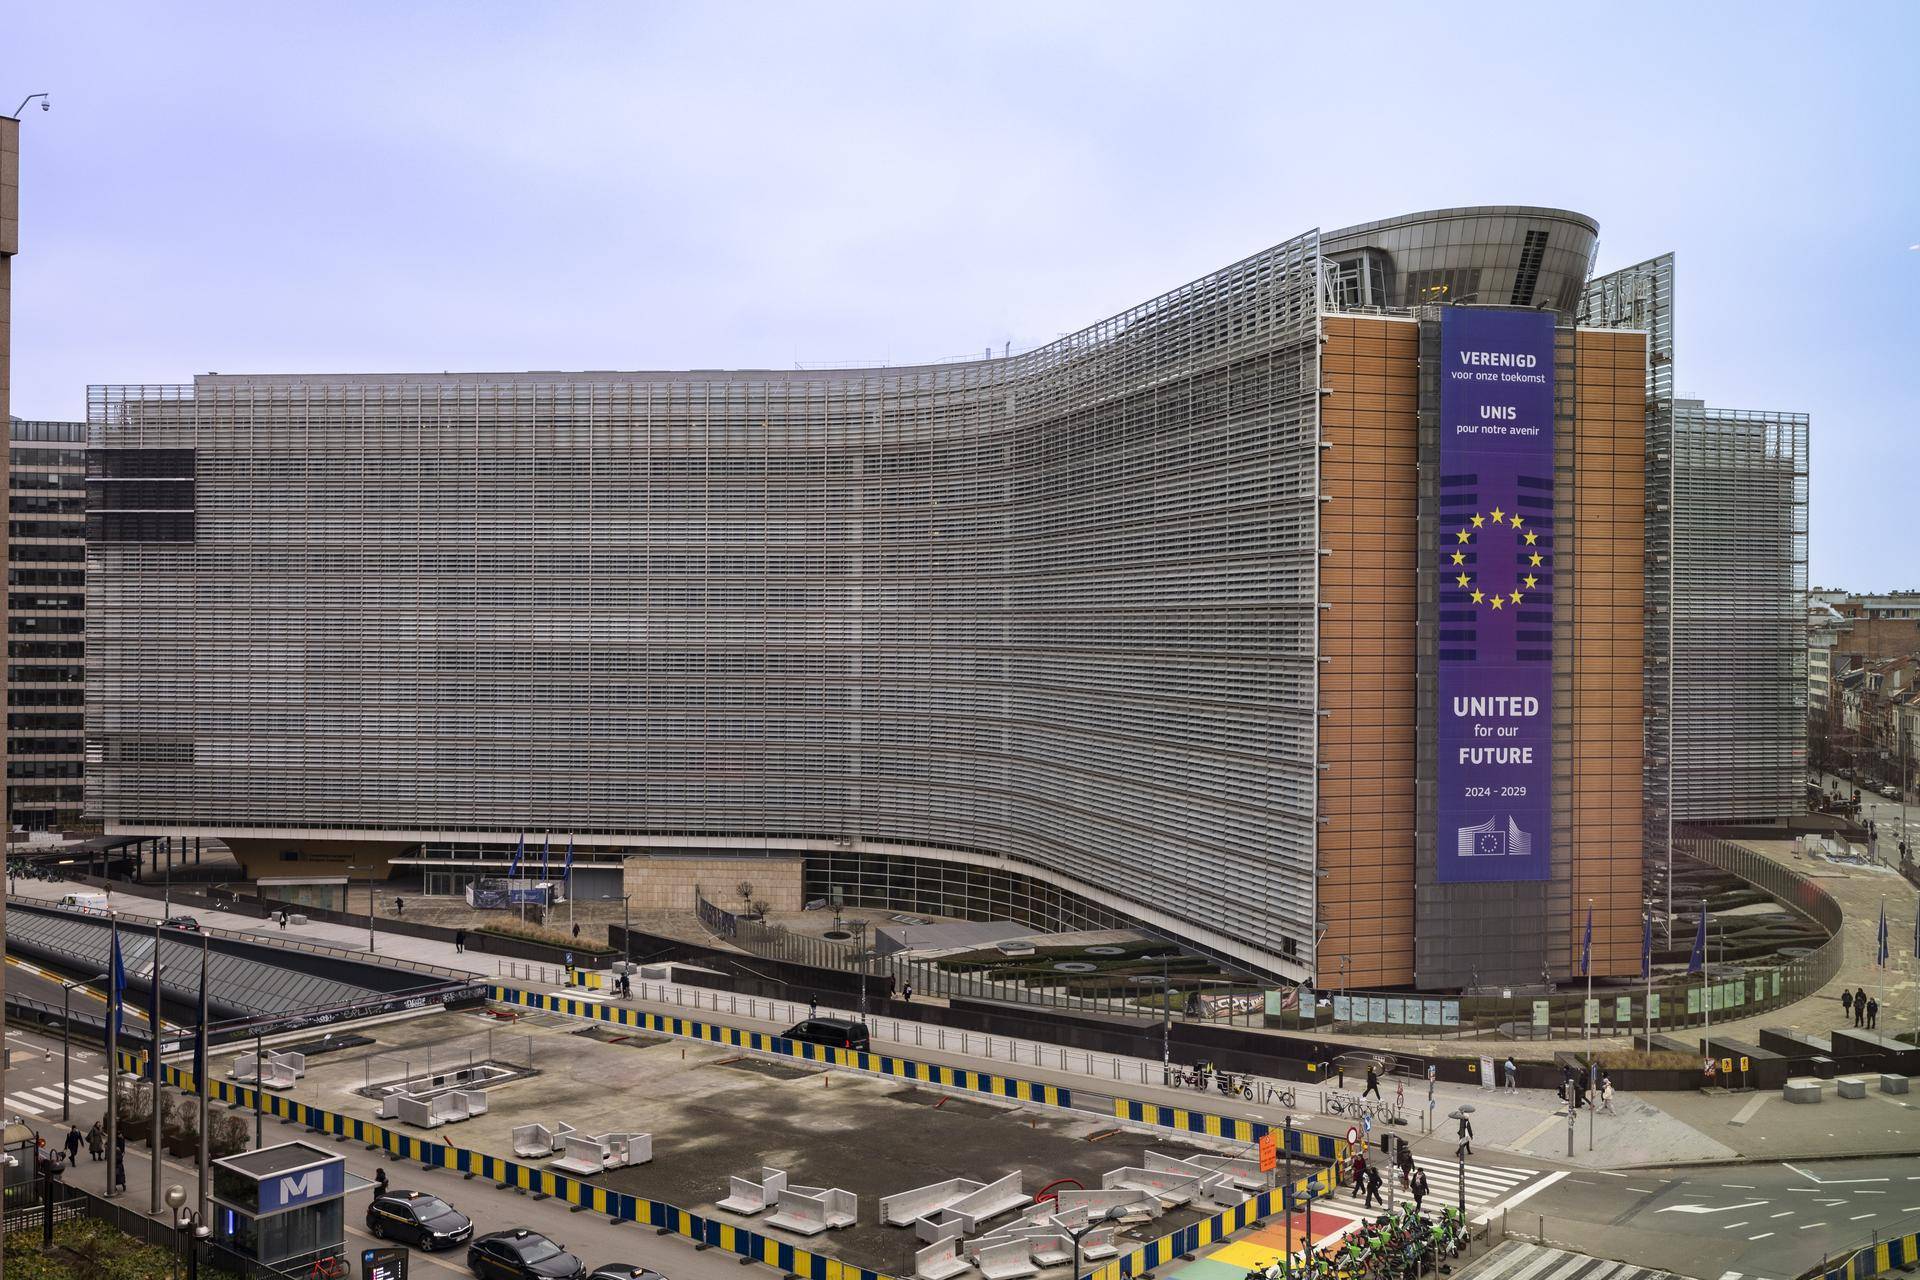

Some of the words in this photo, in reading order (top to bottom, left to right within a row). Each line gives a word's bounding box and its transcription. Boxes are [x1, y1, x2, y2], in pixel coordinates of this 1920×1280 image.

[1460, 351, 1537, 368] VERENIGD
[1451, 371, 1473, 380] voor
[1475, 372, 1498, 382] onze
[1501, 372, 1545, 383] toekomst
[1480, 405, 1517, 420] UNIS
[1456, 425, 1479, 435] pour
[1481, 425, 1507, 435] notre
[1509, 426, 1539, 436] avenir
[1453, 696, 1539, 717] UNITED
[1474, 723, 1493, 737] for
[1497, 725, 1519, 737] our
[1459, 747, 1533, 765] FUTURE
[1464, 786, 1491, 797] 2024
[1500, 786, 1527, 797] 2029
[280, 1169, 324, 1204] M
